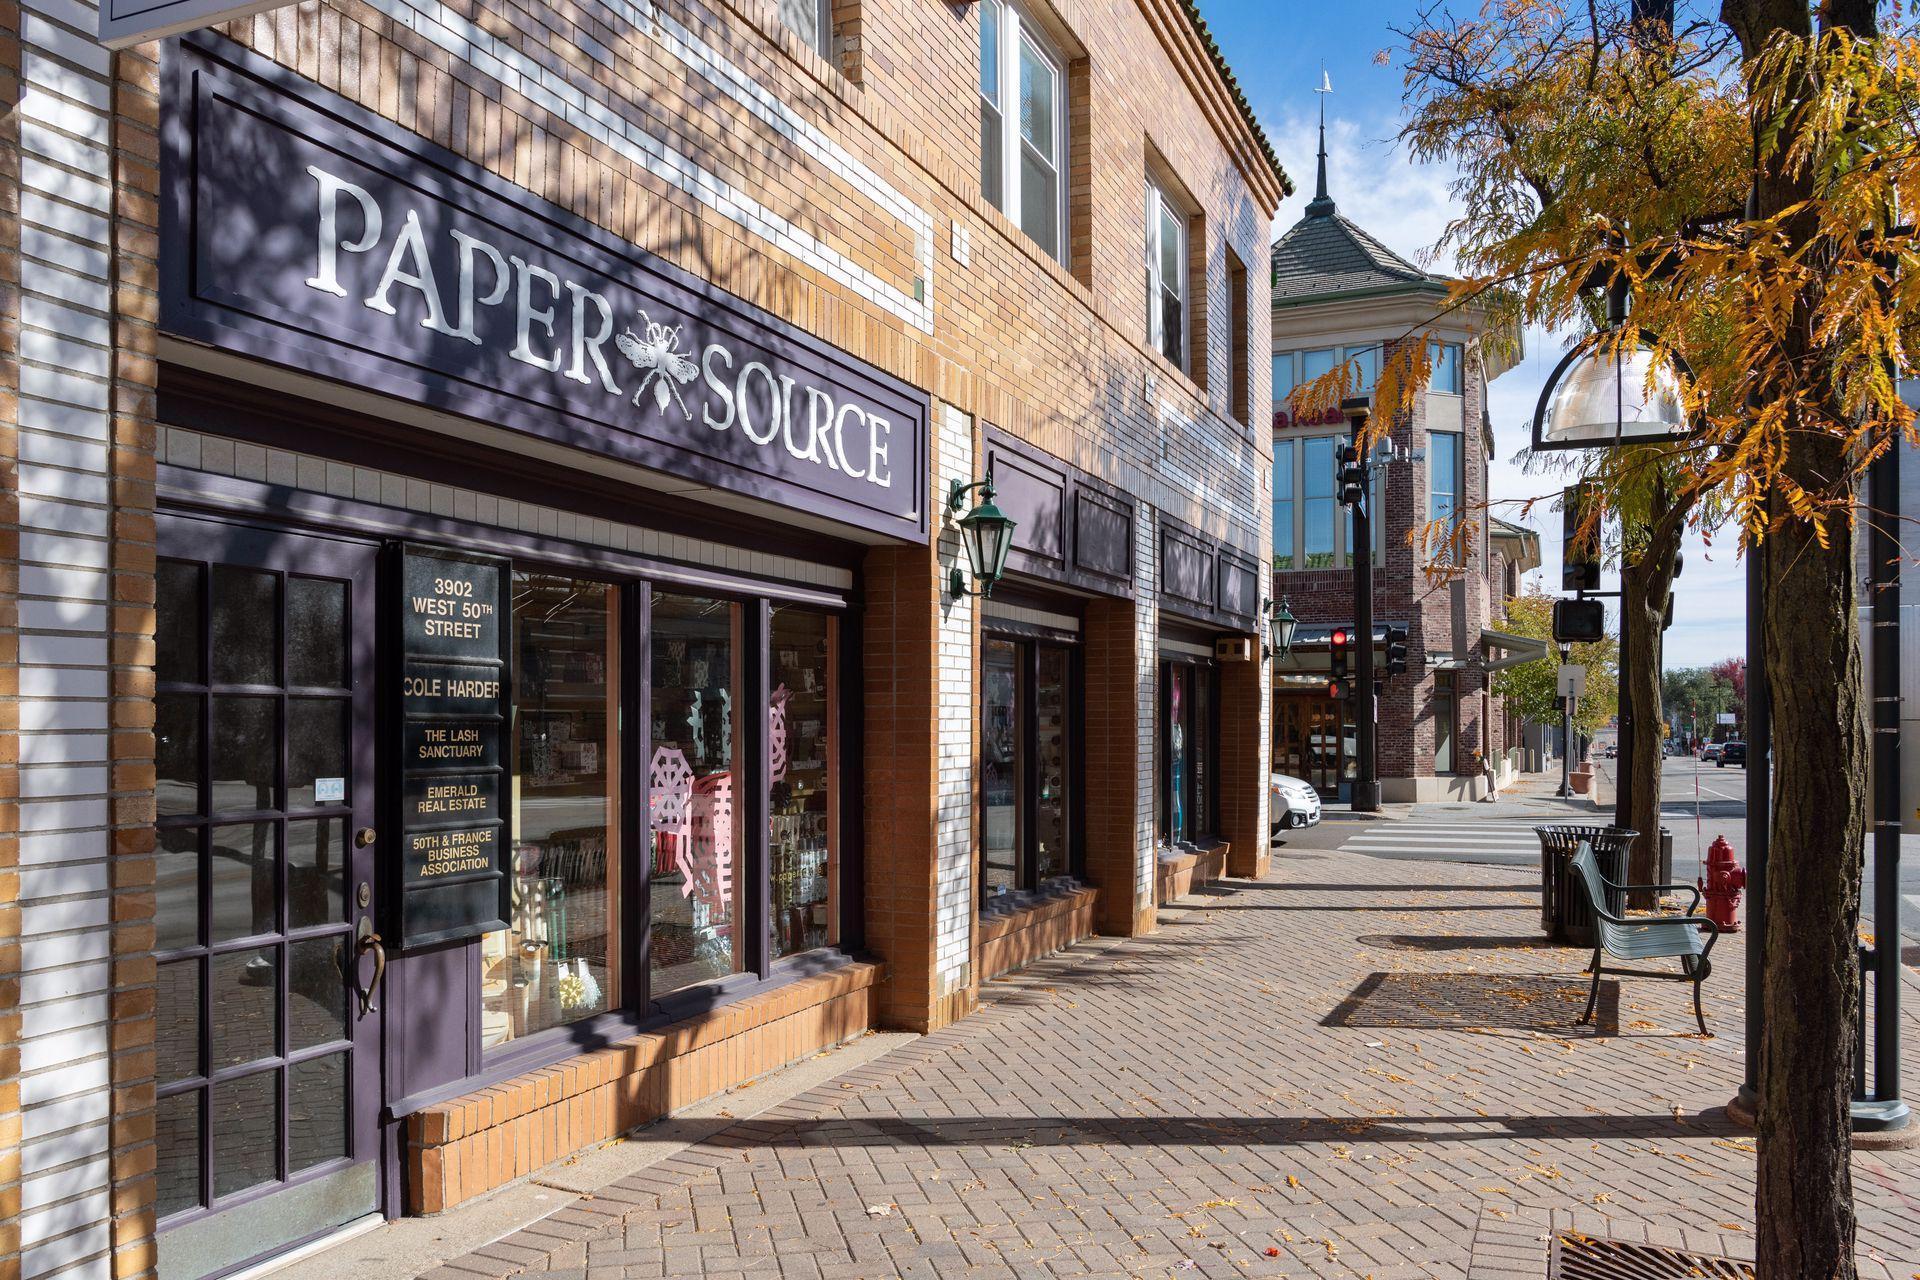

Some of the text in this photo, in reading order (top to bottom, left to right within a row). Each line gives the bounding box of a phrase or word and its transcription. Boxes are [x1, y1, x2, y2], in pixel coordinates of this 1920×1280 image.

[304, 163, 891, 488] PAPER SOURCE
[434, 578, 473, 597] 3902
[412, 597, 493, 619] WEST 50TH
[424, 619, 482, 639] STREET
[447, 679, 500, 699] HARDER
[424, 729, 479, 742] THE LASH
[418, 745, 483, 758] SANCTUARY
[427, 784, 478, 799] EMERALD
[418, 797, 486, 813] REAL ESTATE
[413, 830, 492, 850] 50TH & FRANCE
[428, 845, 480, 862] BUSINESS
[420, 857, 489, 877] ASSOCIATION
